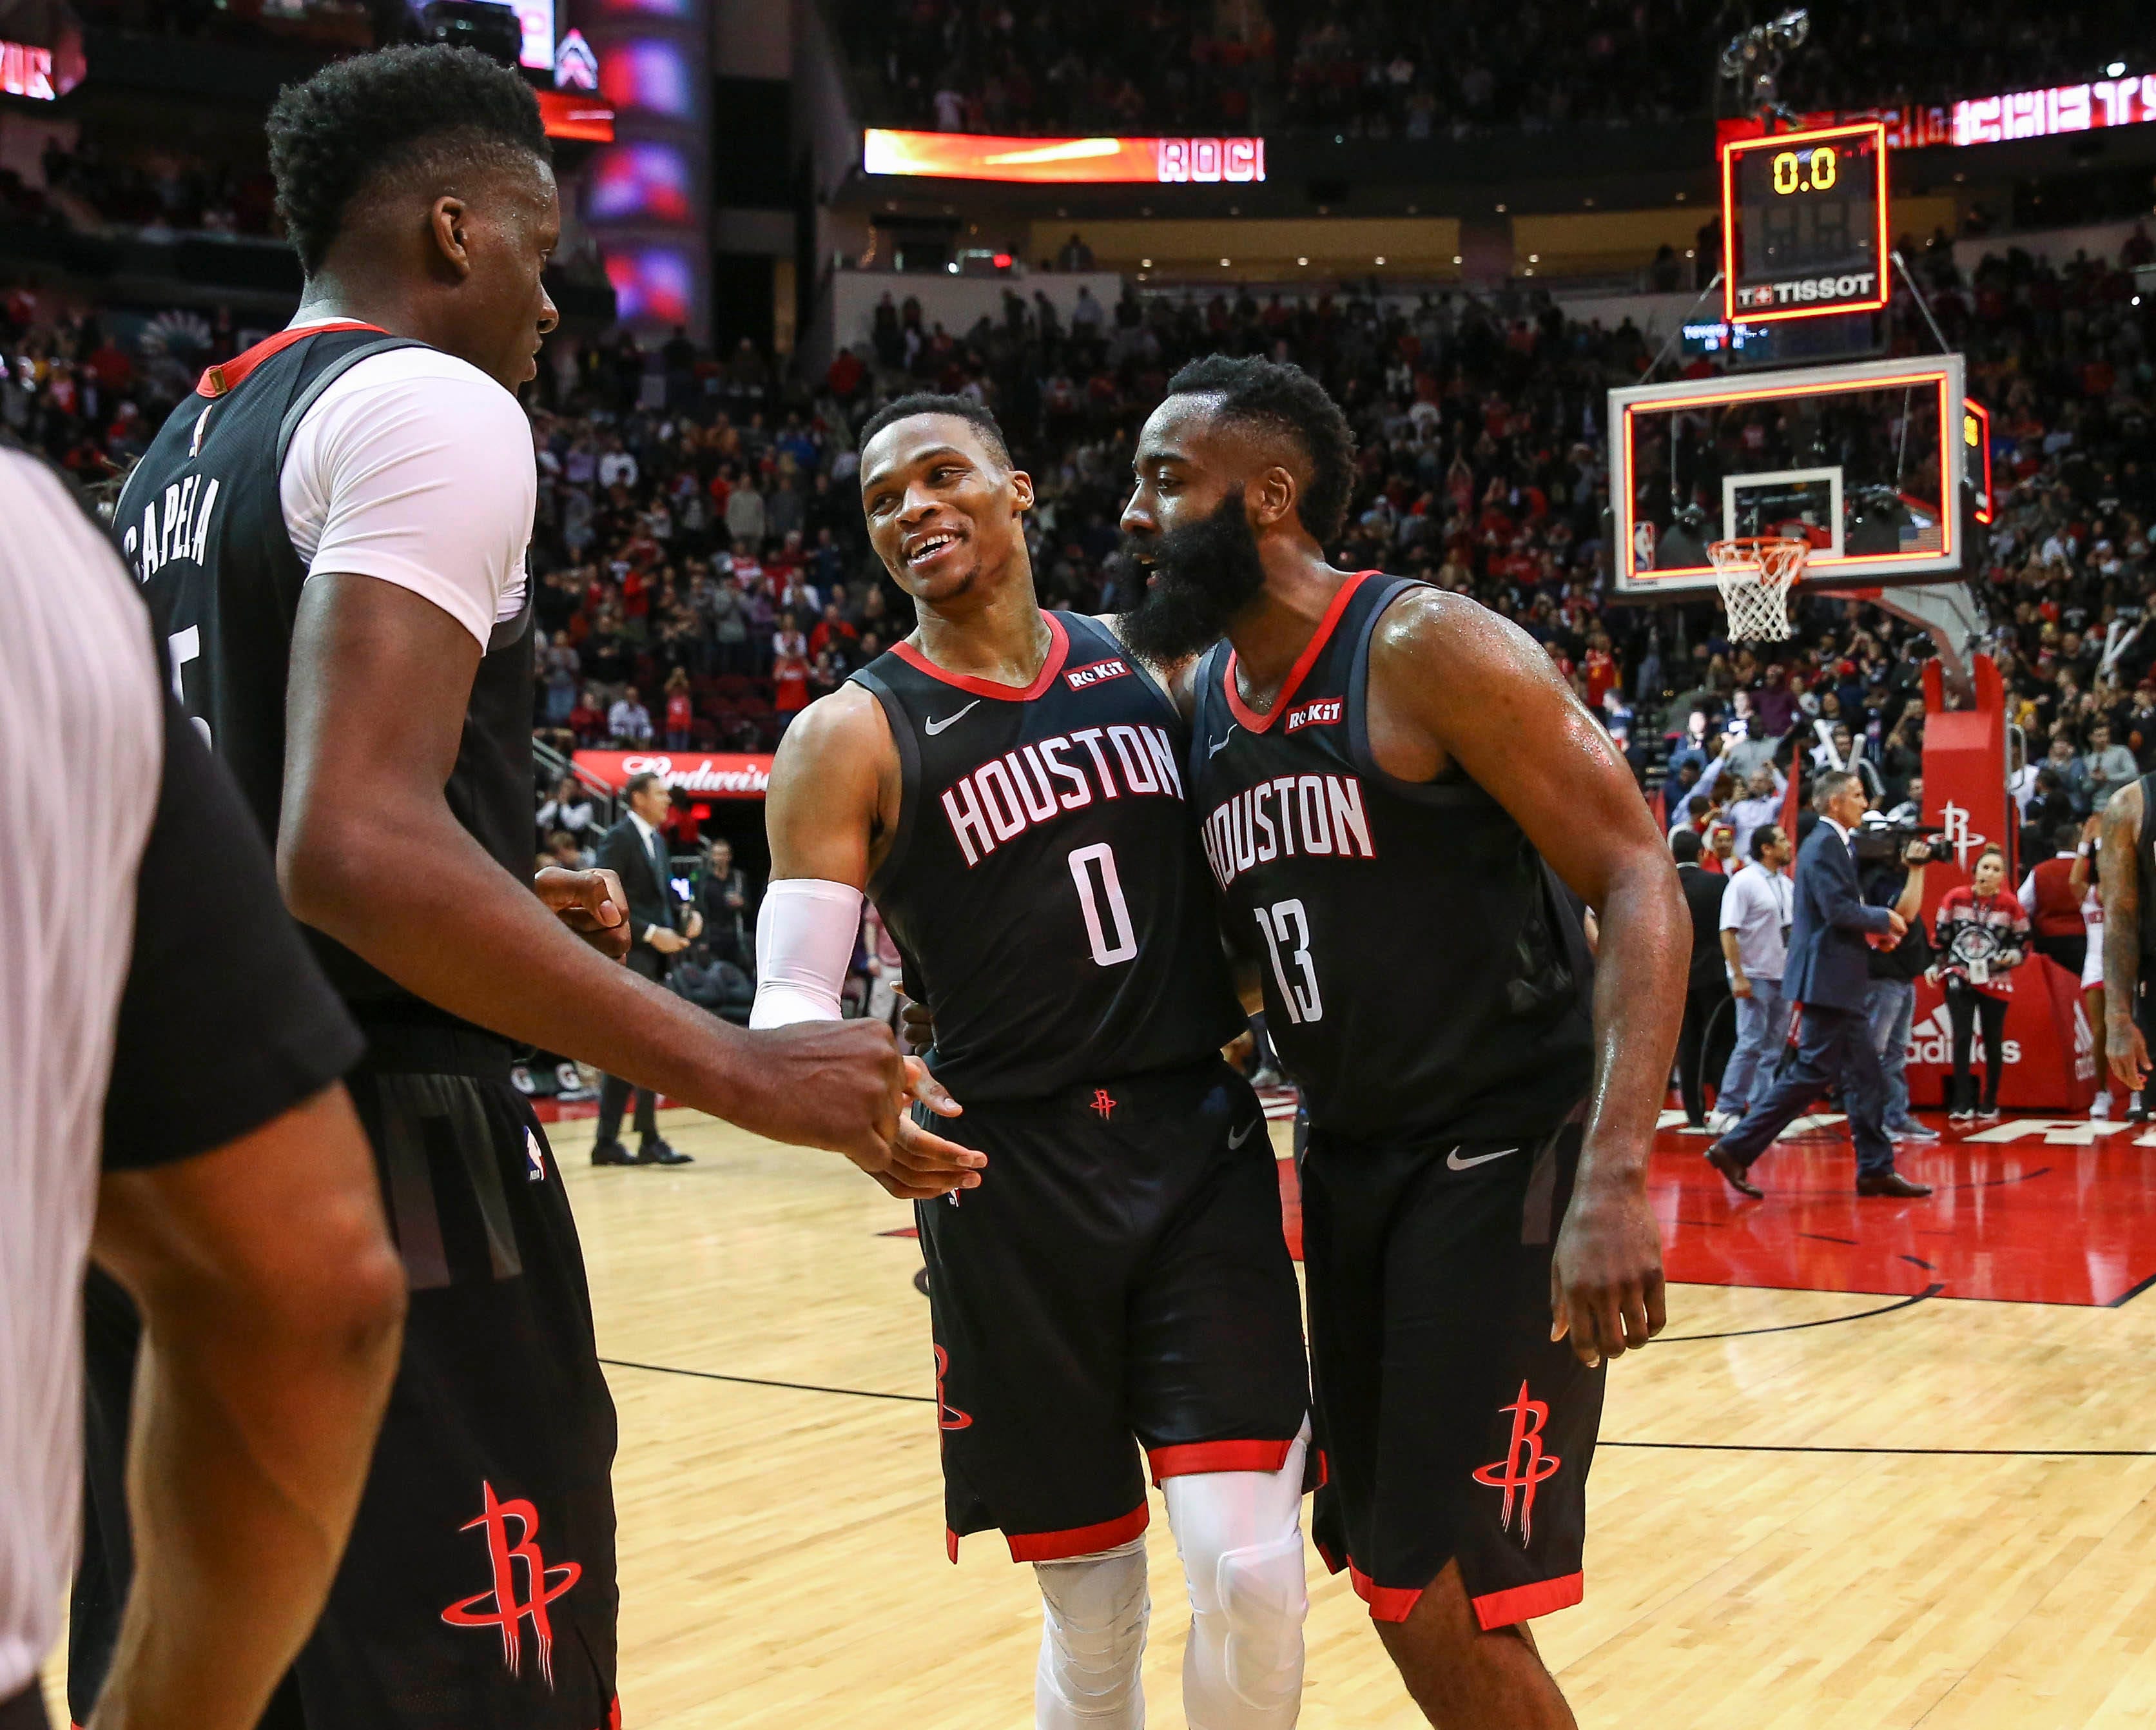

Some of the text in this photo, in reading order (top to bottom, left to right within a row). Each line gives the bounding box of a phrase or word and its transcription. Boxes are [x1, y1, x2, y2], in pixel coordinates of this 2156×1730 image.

[1774, 147, 1836, 195] 0.0
[941, 724, 1185, 868] HOUSTON
[1201, 774, 1375, 892] HOUSTON
[1068, 842, 1138, 966] 0
[1254, 899, 1323, 1024] 13
[1904, 1035, 2022, 1065] adis
